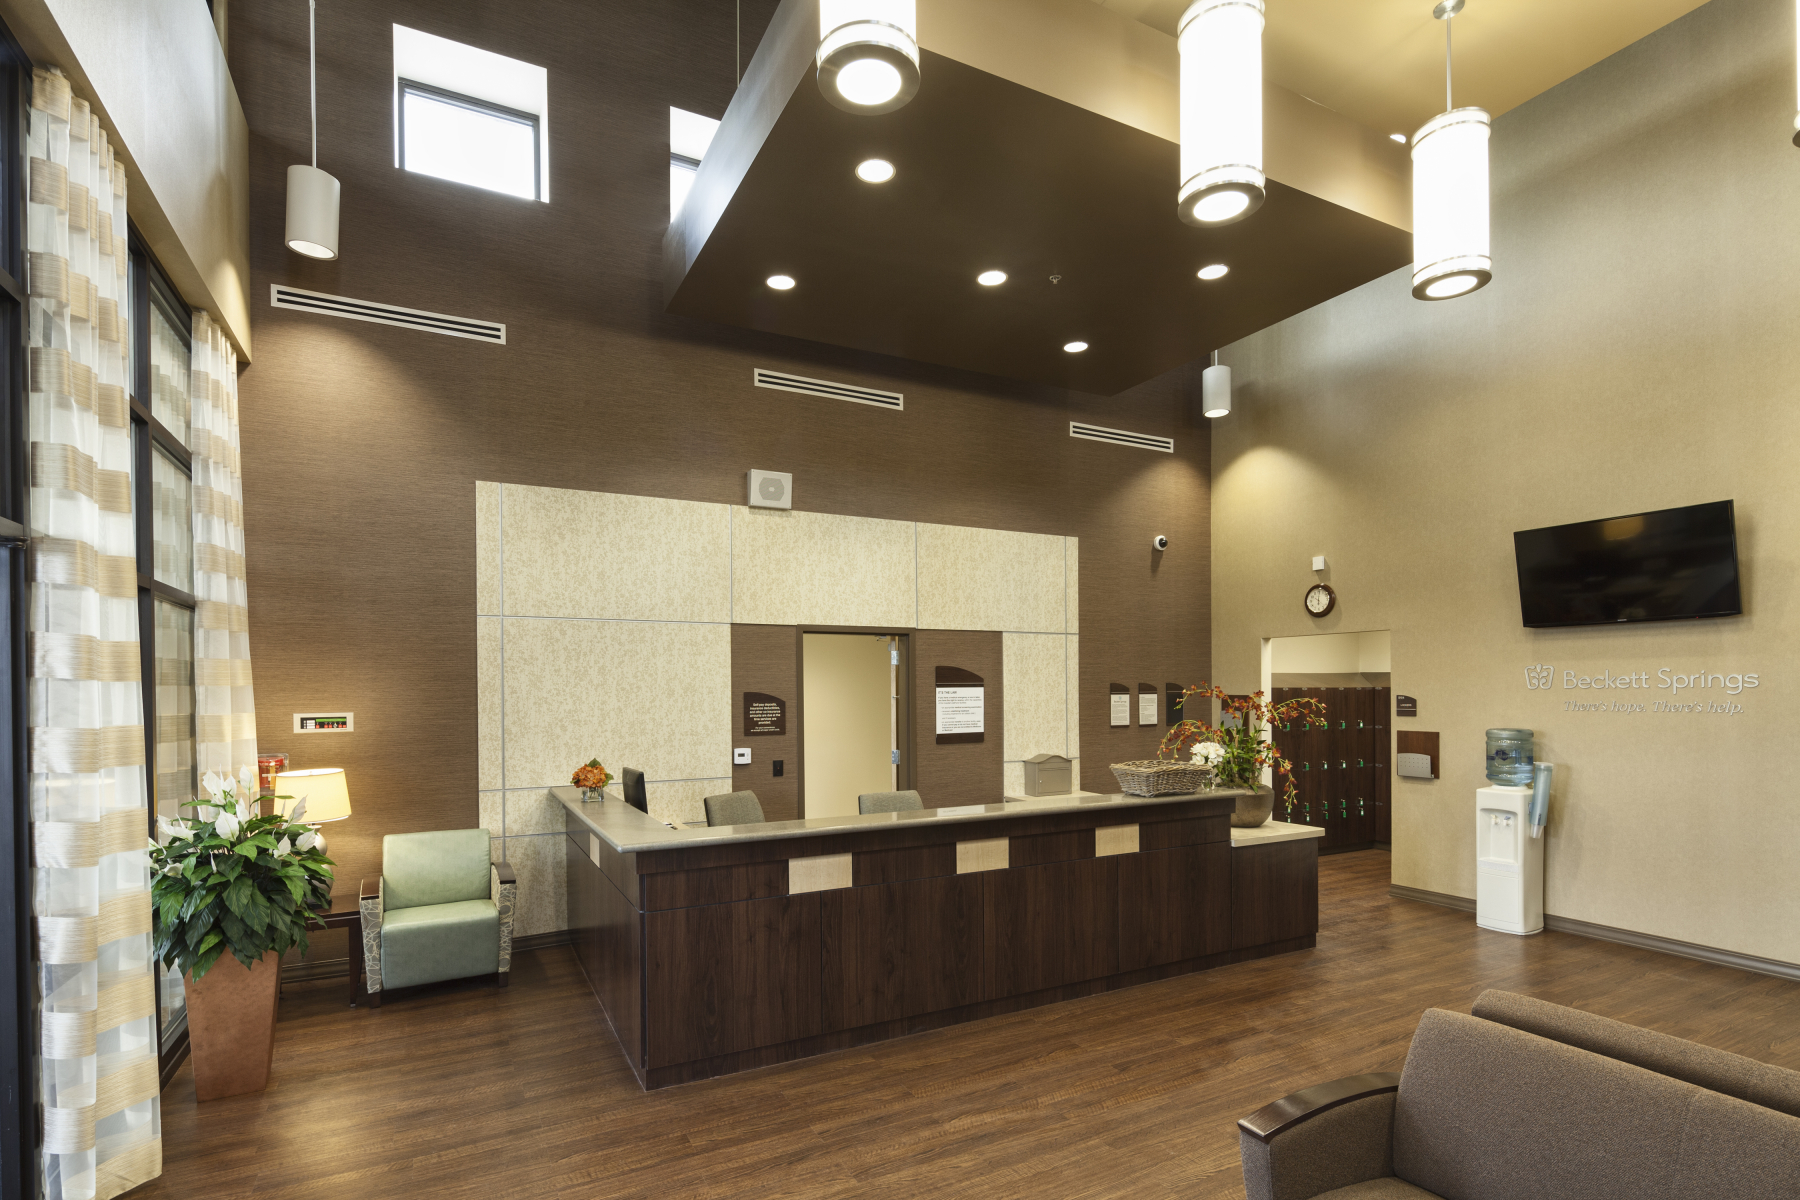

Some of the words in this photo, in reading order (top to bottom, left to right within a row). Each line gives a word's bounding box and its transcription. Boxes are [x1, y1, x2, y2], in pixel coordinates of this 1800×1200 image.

[1563, 669, 1650, 689] Beckett
[1657, 667, 1759, 695] Springs
[1563, 700, 1608, 712] There's
[1610, 700, 1647, 715] hope.
[1652, 700, 1704, 713] There's
[1707, 700, 1745, 716] help.
